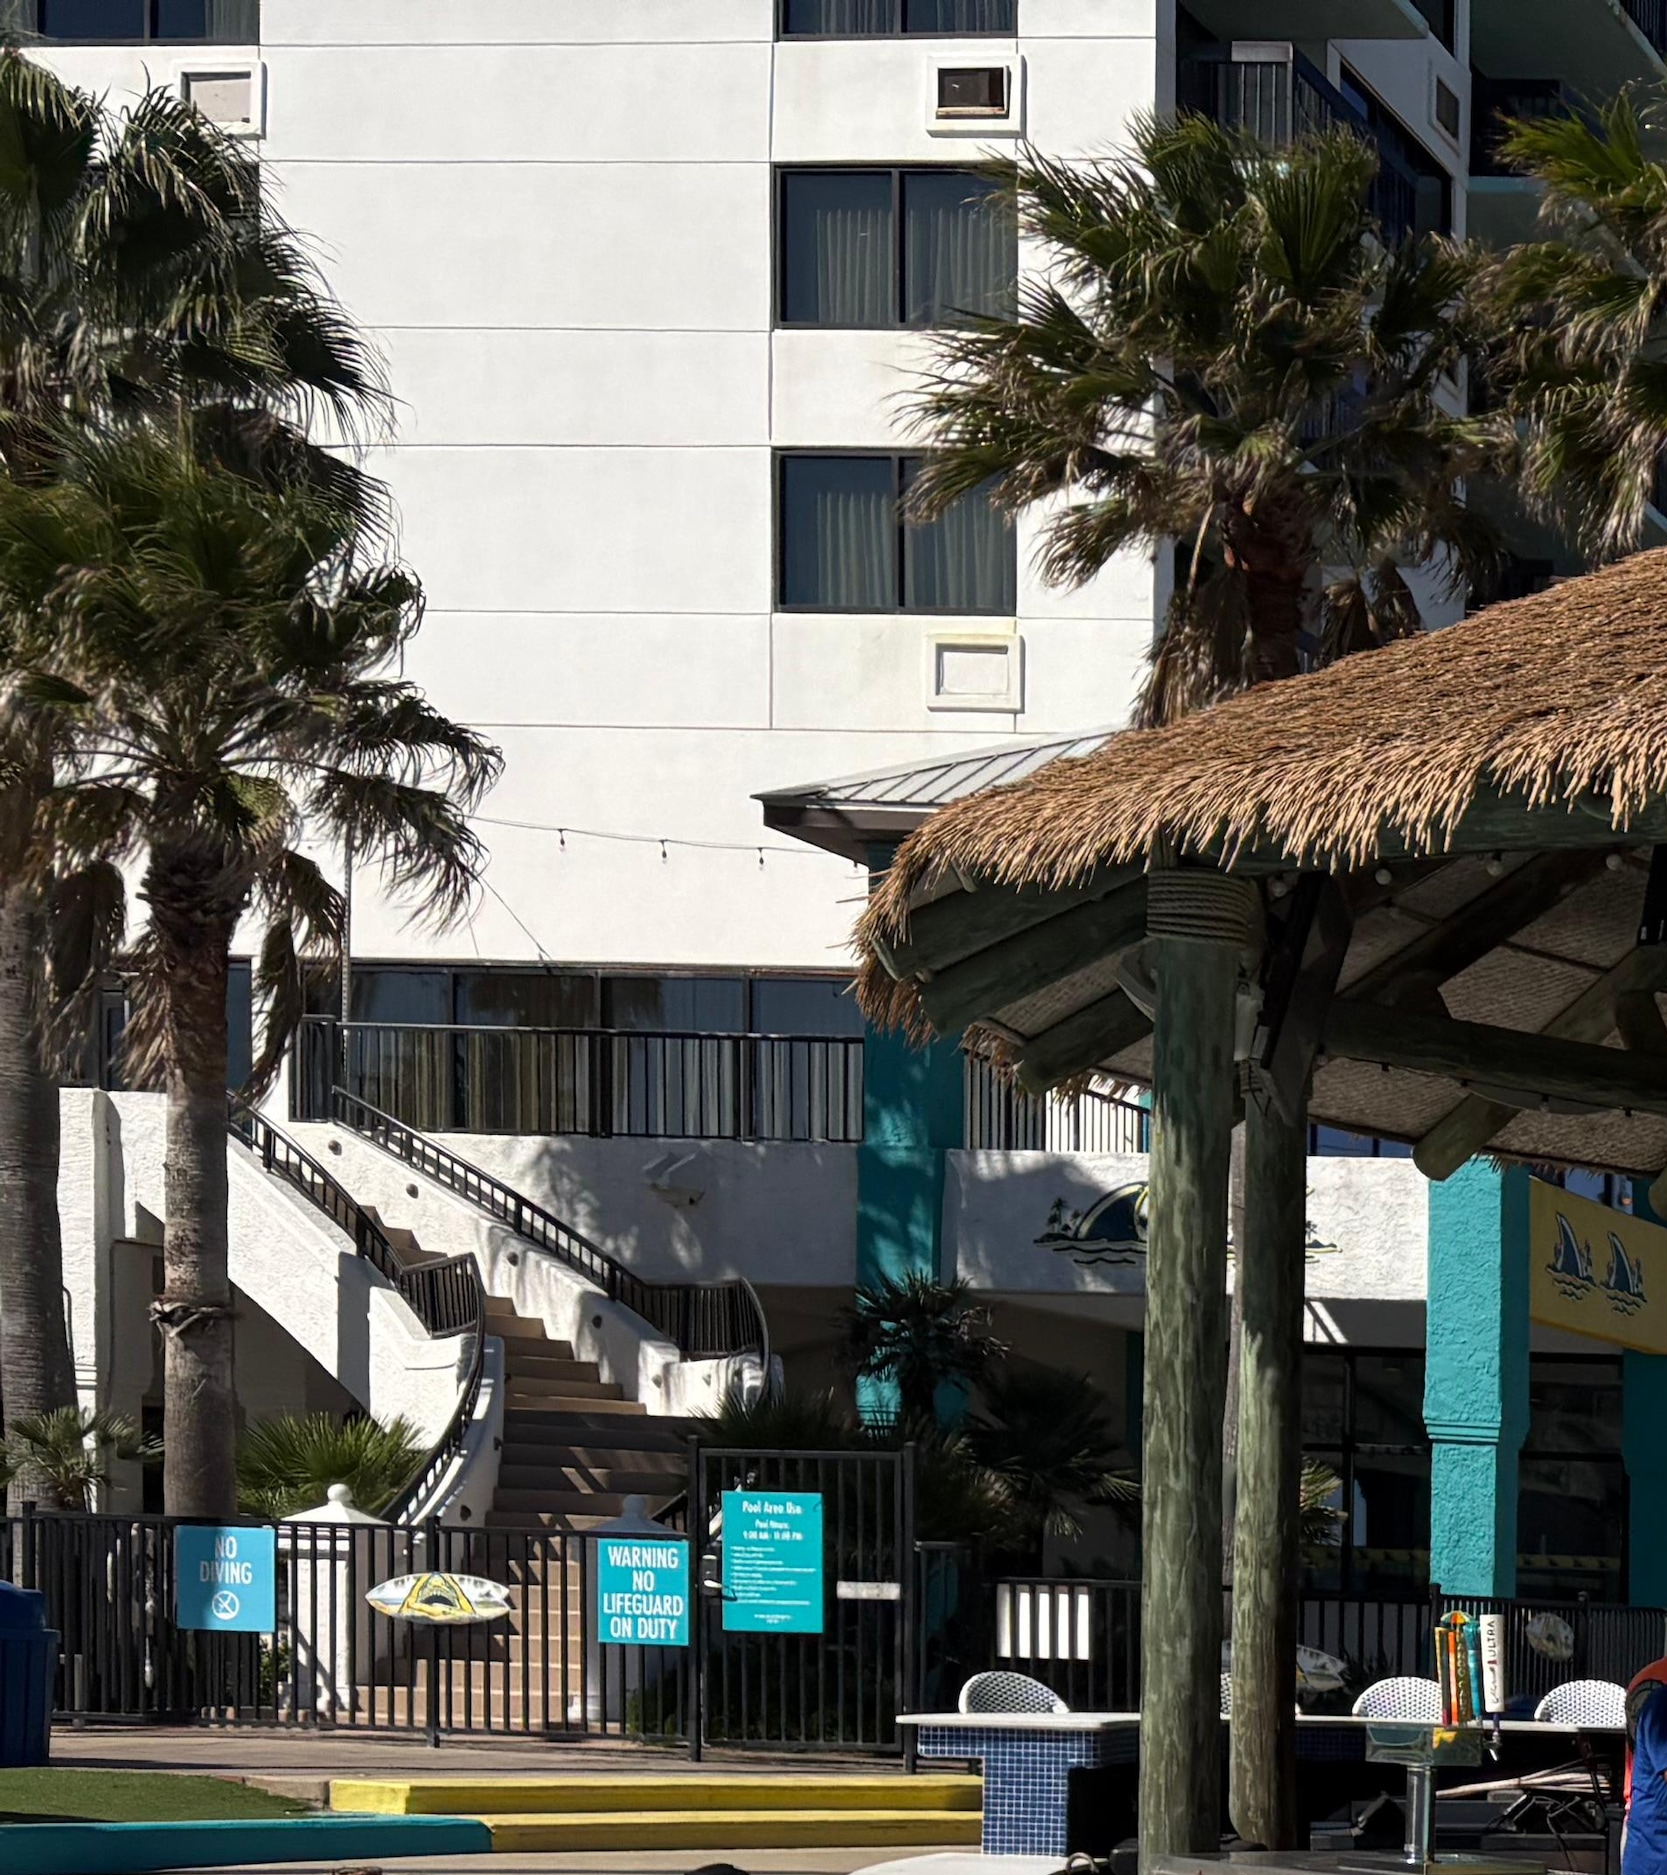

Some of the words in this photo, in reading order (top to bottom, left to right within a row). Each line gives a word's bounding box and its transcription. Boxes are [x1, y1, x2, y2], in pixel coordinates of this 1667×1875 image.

[742, 1500, 761, 1513] Pool
[214, 1536, 238, 1560] NO
[607, 1545, 679, 1569] WARNING
[200, 1560, 253, 1585] DIVING
[632, 1569, 655, 1592] NO
[603, 1592, 684, 1617] LIFEGUARD
[610, 1616, 632, 1639] ON
[637, 1617, 678, 1640] DUTY
[1486, 1620, 1498, 1659] ULTRA
